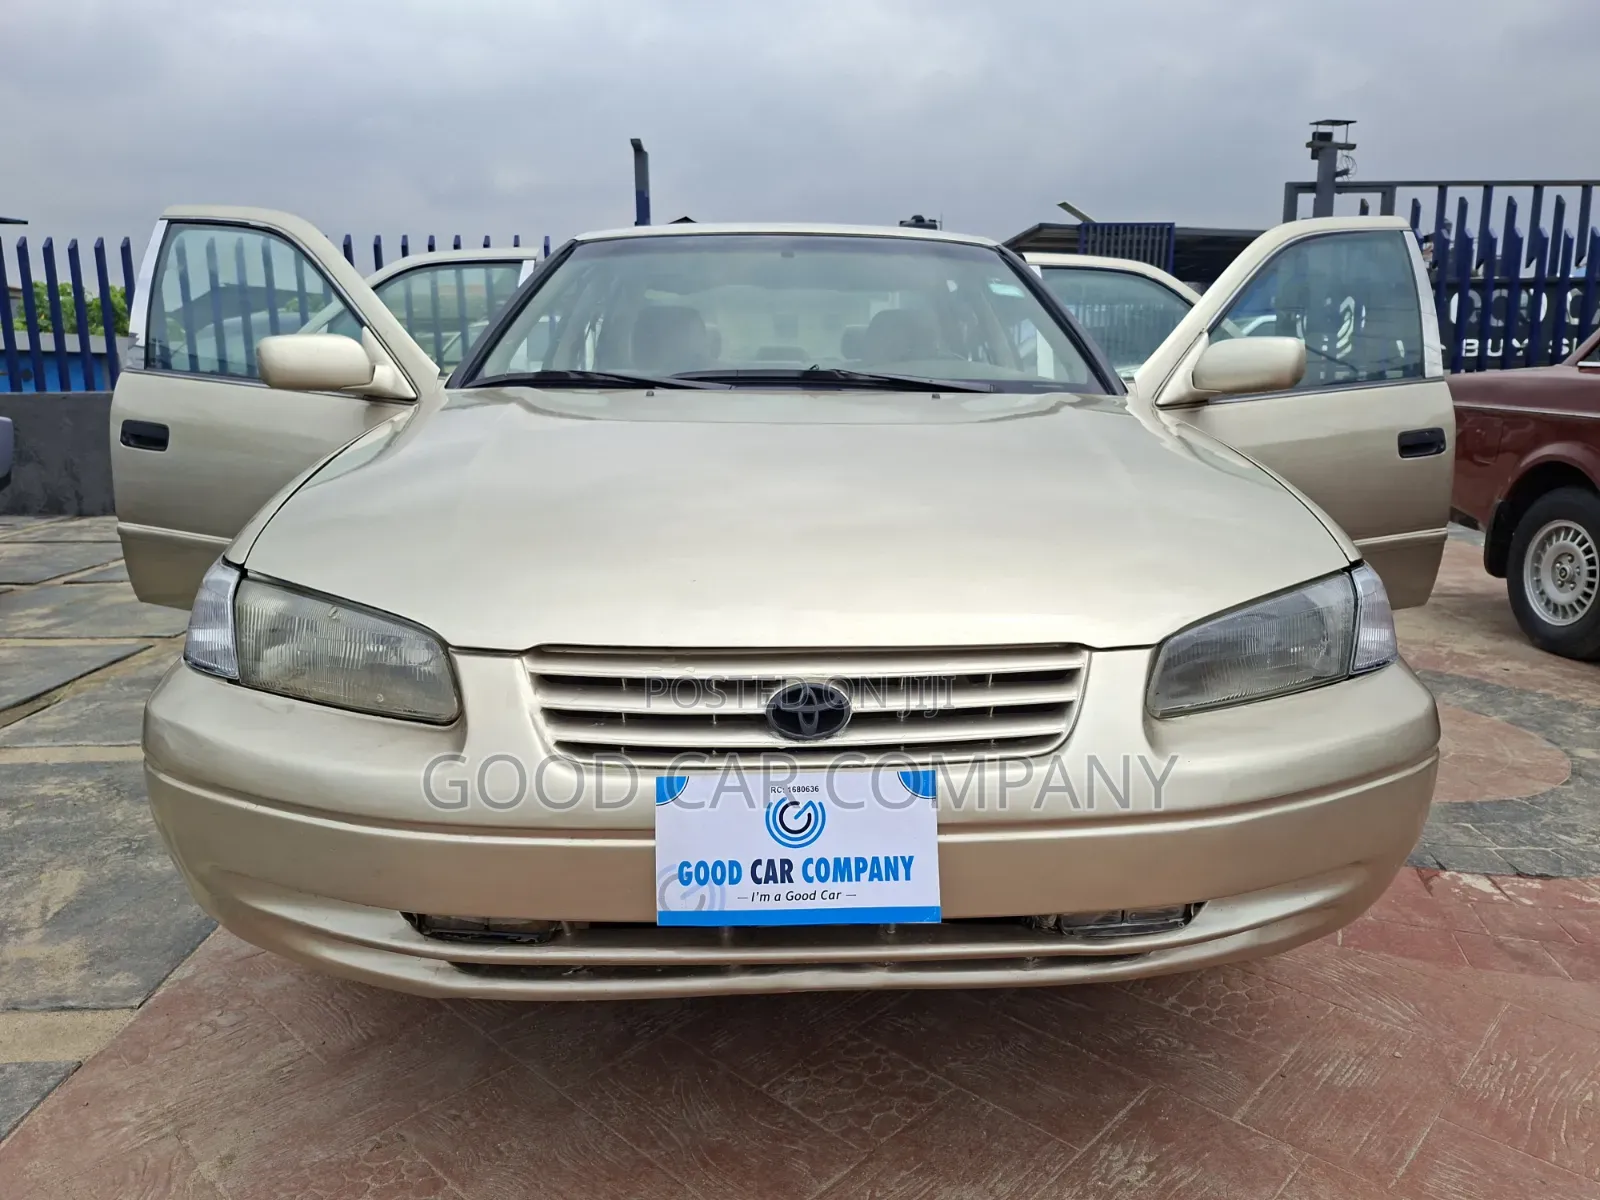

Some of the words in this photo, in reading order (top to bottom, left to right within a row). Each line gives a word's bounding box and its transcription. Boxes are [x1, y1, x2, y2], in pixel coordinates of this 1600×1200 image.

[1461, 337, 1530, 358] BUY
[677, 859, 743, 887] GOOD
[750, 857, 795, 885] CAR
[801, 855, 915, 884] COMPANY
[751, 891, 771, 902] I'm
[774, 893, 782, 901] a
[785, 890, 817, 902] Good
[820, 889, 842, 900] Car
